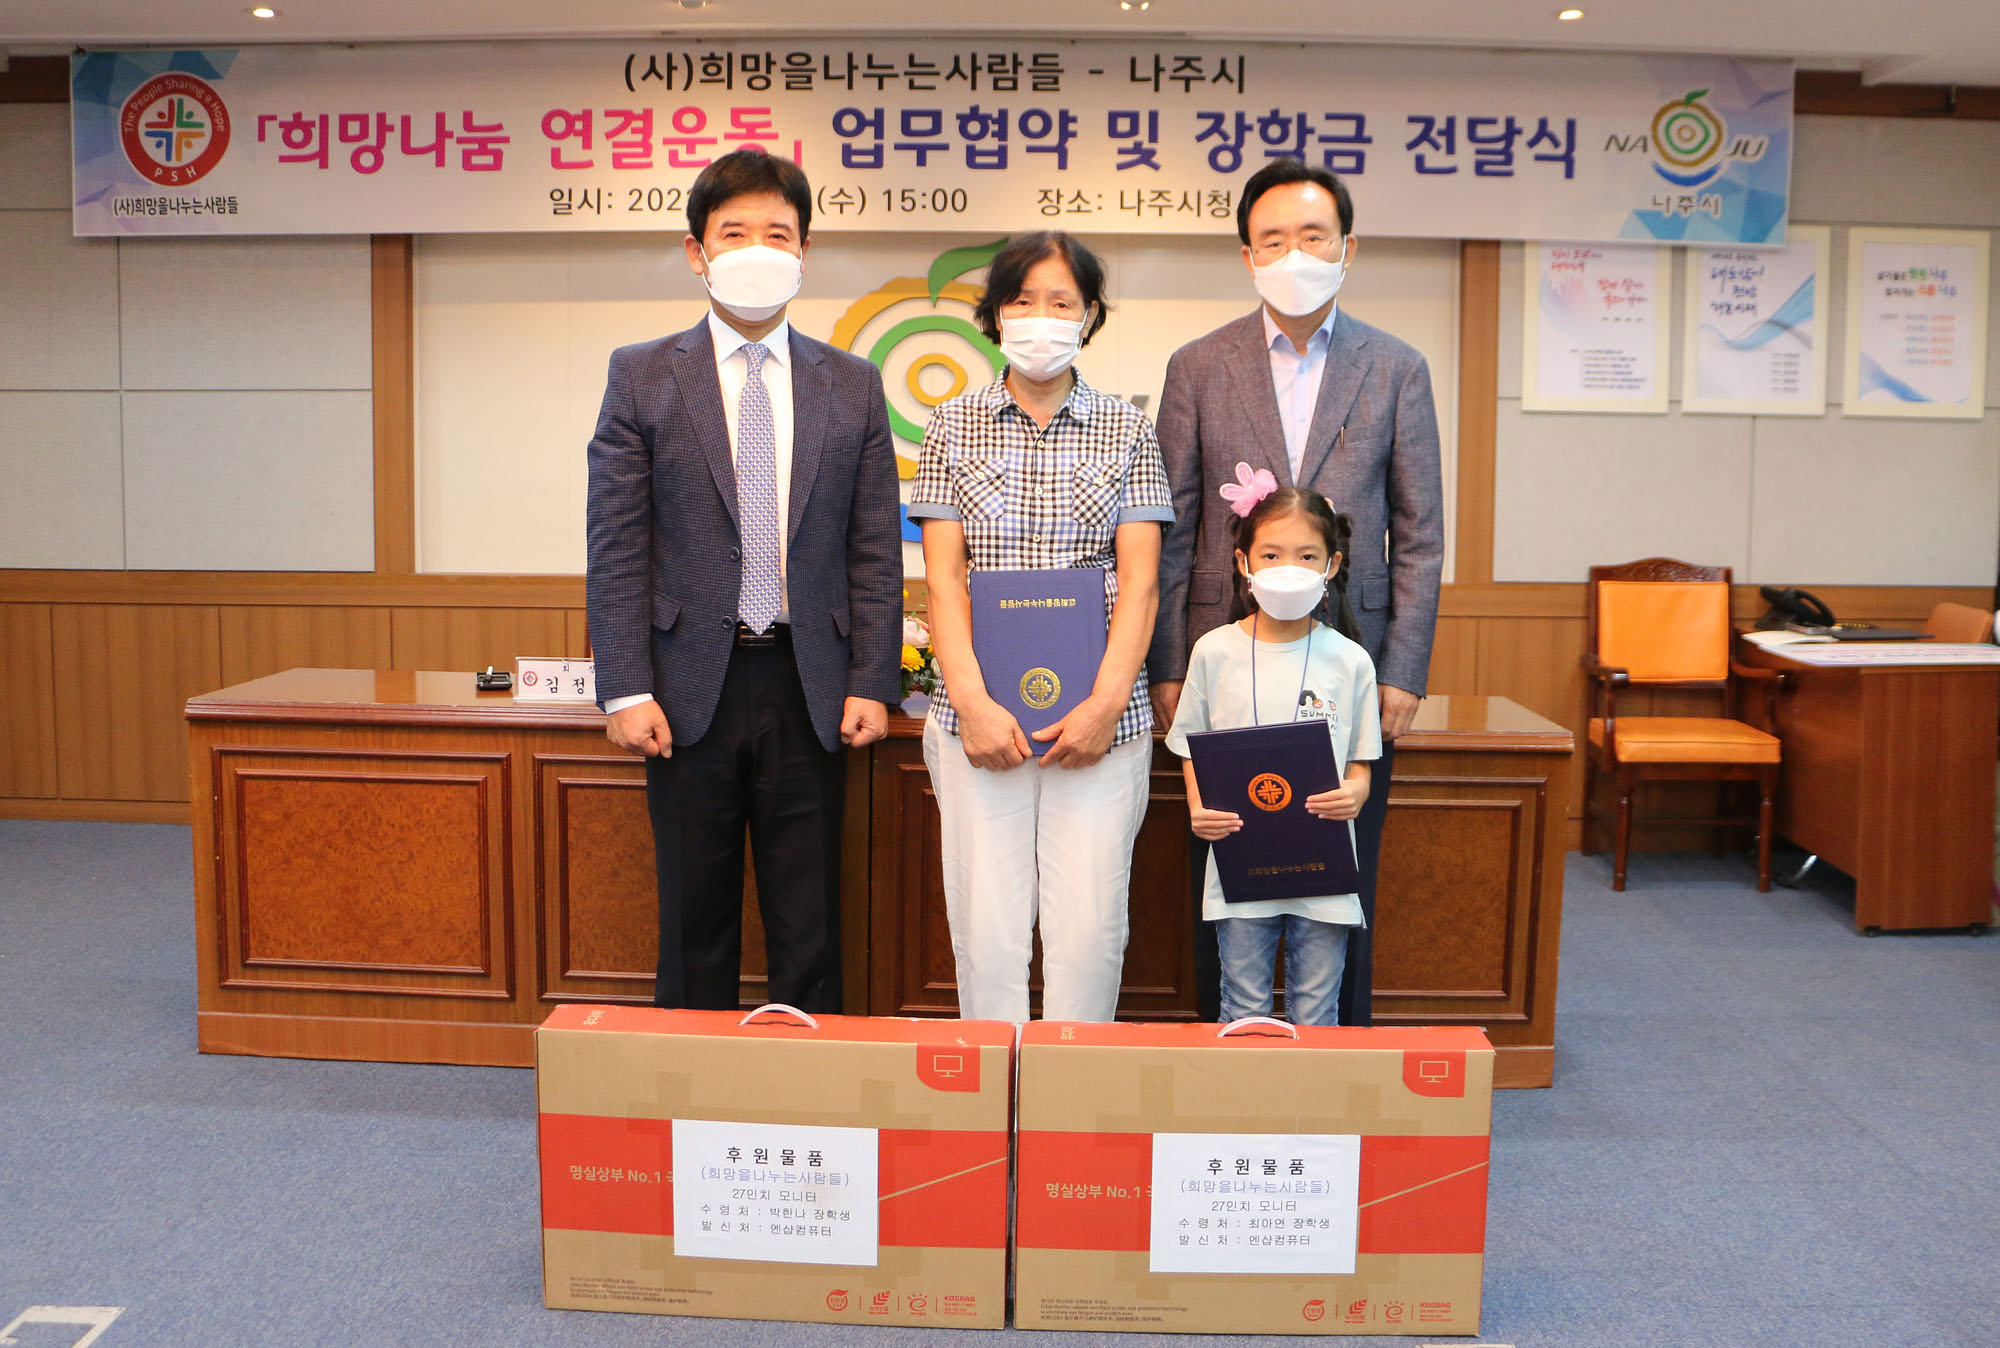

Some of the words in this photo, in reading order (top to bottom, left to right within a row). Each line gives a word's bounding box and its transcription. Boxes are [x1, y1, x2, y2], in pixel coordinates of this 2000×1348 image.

[624, 51, 1064, 93] (사)희망을나누는사람들
[1129, 53, 1246, 94] 나주시
[124, 111, 136, 133] The
[132, 83, 163, 110] People
[165, 77, 205, 98] Sharing
[211, 102, 225, 132] Hope
[257, 108, 511, 175] 「희망나눔
[832, 104, 1077, 171] 업무협약
[1107, 109, 1162, 172] 및
[1194, 107, 1374, 176] 장학금
[1404, 114, 1577, 180] 전달식
[1604, 133, 1649, 154] NA
[1725, 137, 1770, 158] JU
[114, 196, 238, 216] (사)희망을나누는사람들
[549, 187, 614, 216] 일시:
[628, 187, 692, 213] 202
[881, 188, 968, 213] 15:00
[1037, 187, 1104, 217] 장소:
[1118, 188, 1233, 219] 나주시청
[1652, 194, 1722, 216] 나주시
[545, 676, 559, 694] 김
[571, 677, 585, 695] 정
[569, 1165, 624, 1182] 명실상부
[628, 1168, 662, 1184] No.1
[701, 1166, 850, 1187] (희망을나누는사람들)
[732, 1188, 771, 1201] 27인치
[779, 1190, 817, 1203] 모니터
[1046, 1182, 1103, 1199] 명실상부
[1106, 1184, 1141, 1199] No.1
[1180, 1179, 1331, 1194] (희망을나누는사람들)
[769, 1207, 806, 1220] 박한나
[814, 1209, 851, 1221] 장학생
[1211, 1200, 1251, 1212] 27인치
[1259, 1200, 1297, 1212] 모니터
[1249, 1217, 1285, 1229] 최아연
[1293, 1217, 1330, 1229] 장학생
